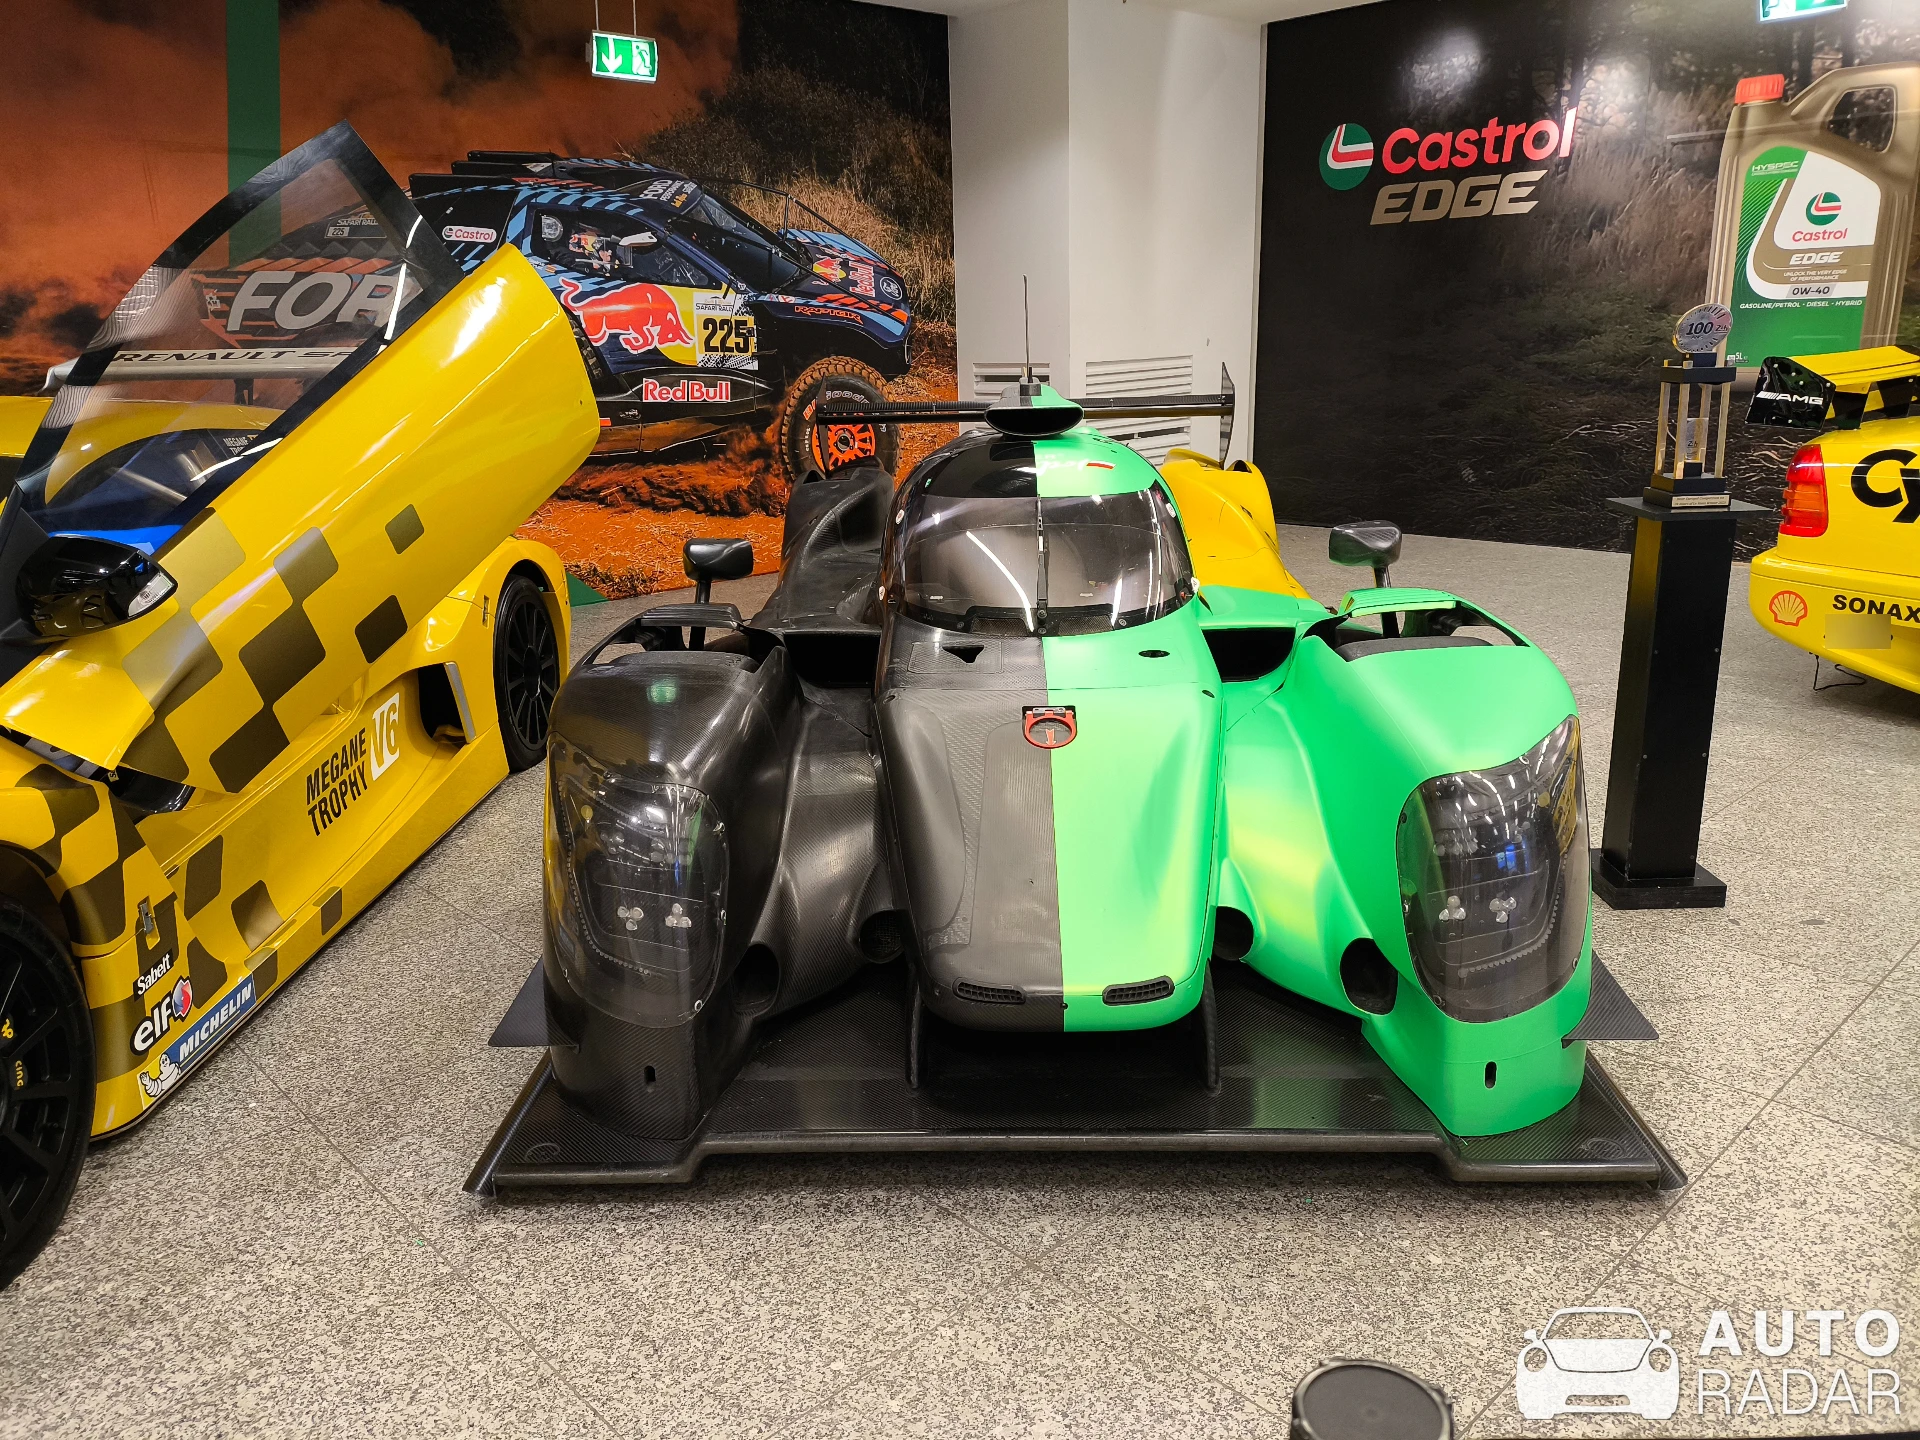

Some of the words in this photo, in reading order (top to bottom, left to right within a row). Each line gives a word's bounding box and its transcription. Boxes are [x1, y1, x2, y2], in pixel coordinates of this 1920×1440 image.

[1382, 106, 1578, 174] Castrol
[638, 180, 673, 200] FORD
[1369, 169, 1549, 226] EDGE
[331, 227, 346, 236] 225
[454, 229, 494, 241] Castrol
[1791, 228, 1849, 243] Castrol
[1789, 251, 1844, 266] EDGE
[702, 317, 750, 354] 225
[1685, 321, 1714, 336] 100
[111, 349, 296, 362] RENAULT
[642, 378, 688, 402] Red
[688, 379, 731, 402] Bull
[1775, 393, 1824, 405] AMG
[371, 694, 400, 780] V6
[306, 727, 367, 806] MEGANE
[307, 760, 368, 837] TROPHY
[137, 952, 172, 996] Sabelt
[133, 995, 172, 1051] elf
[179, 982, 252, 1063] MICHELIN
